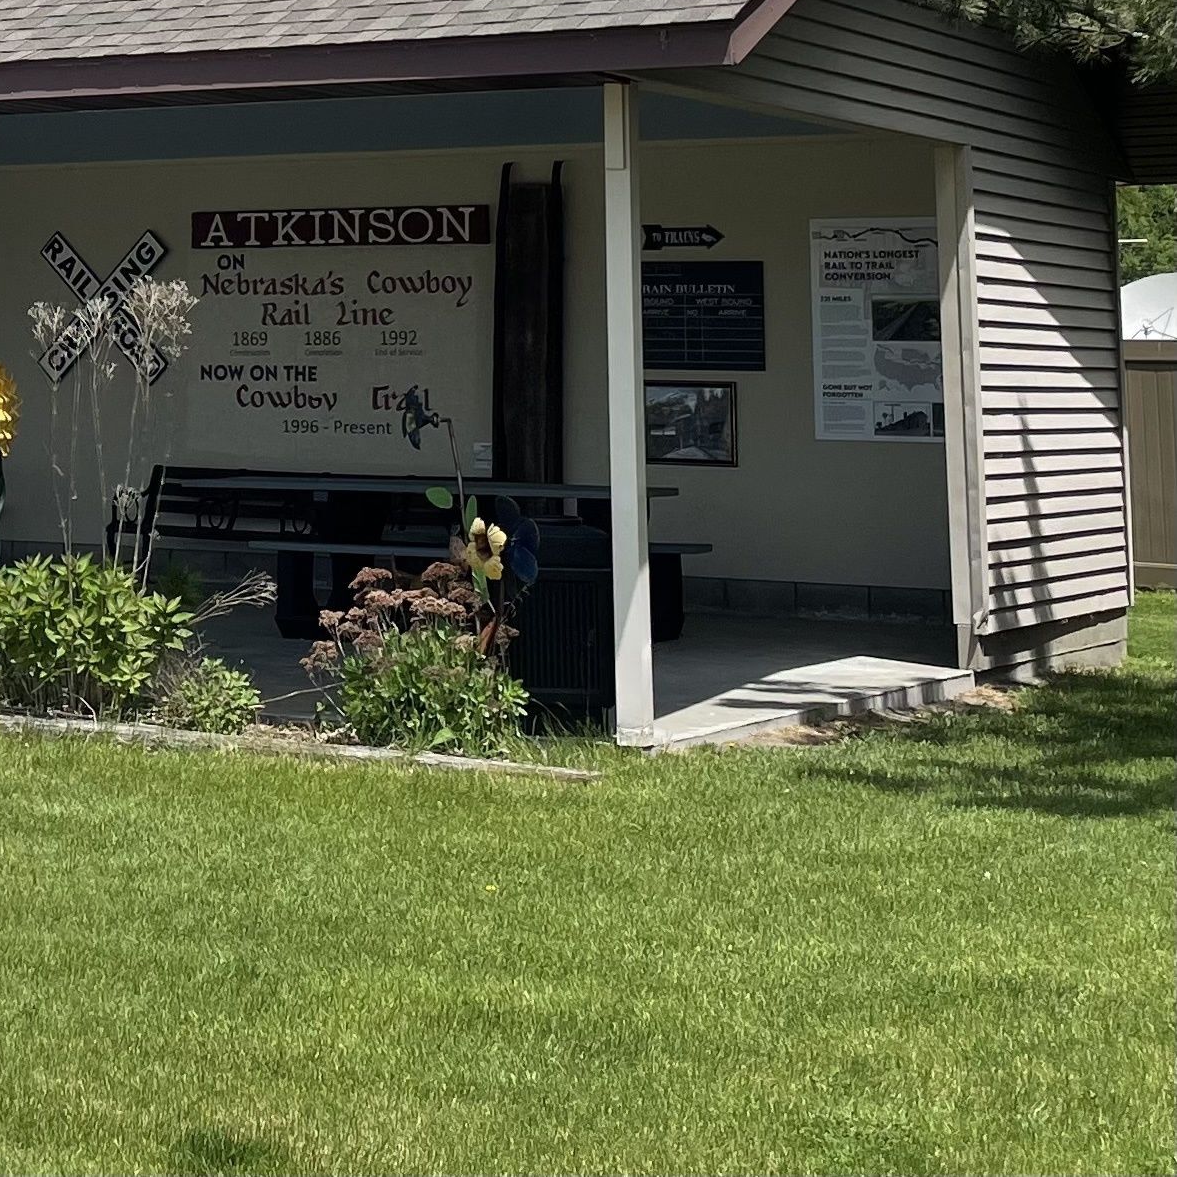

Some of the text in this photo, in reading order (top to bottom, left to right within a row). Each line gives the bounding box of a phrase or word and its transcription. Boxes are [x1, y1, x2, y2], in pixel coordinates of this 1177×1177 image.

[200, 207, 476, 247] ATKINSON
[664, 230, 700, 244] TRAINS
[217, 253, 245, 270] ON
[824, 250, 919, 259] NATION'S LONGEST
[44, 237, 92, 300] RAIL
[824, 261, 895, 270] RAIL TO TRAIL
[824, 272, 891, 281] CONVERSION
[200, 270, 473, 308] Nebraska's Cowboy
[643, 284, 735, 294] RAIN BULLETIN
[261, 301, 395, 327] Rail Line
[232, 331, 268, 346] 1869
[304, 330, 341, 346] 1886
[380, 330, 417, 346] 1992
[200, 365, 318, 382] NOW ON THE
[371, 384, 432, 412] Tral
[282, 419, 319, 434] 1996
[333, 419, 392, 435] Present
